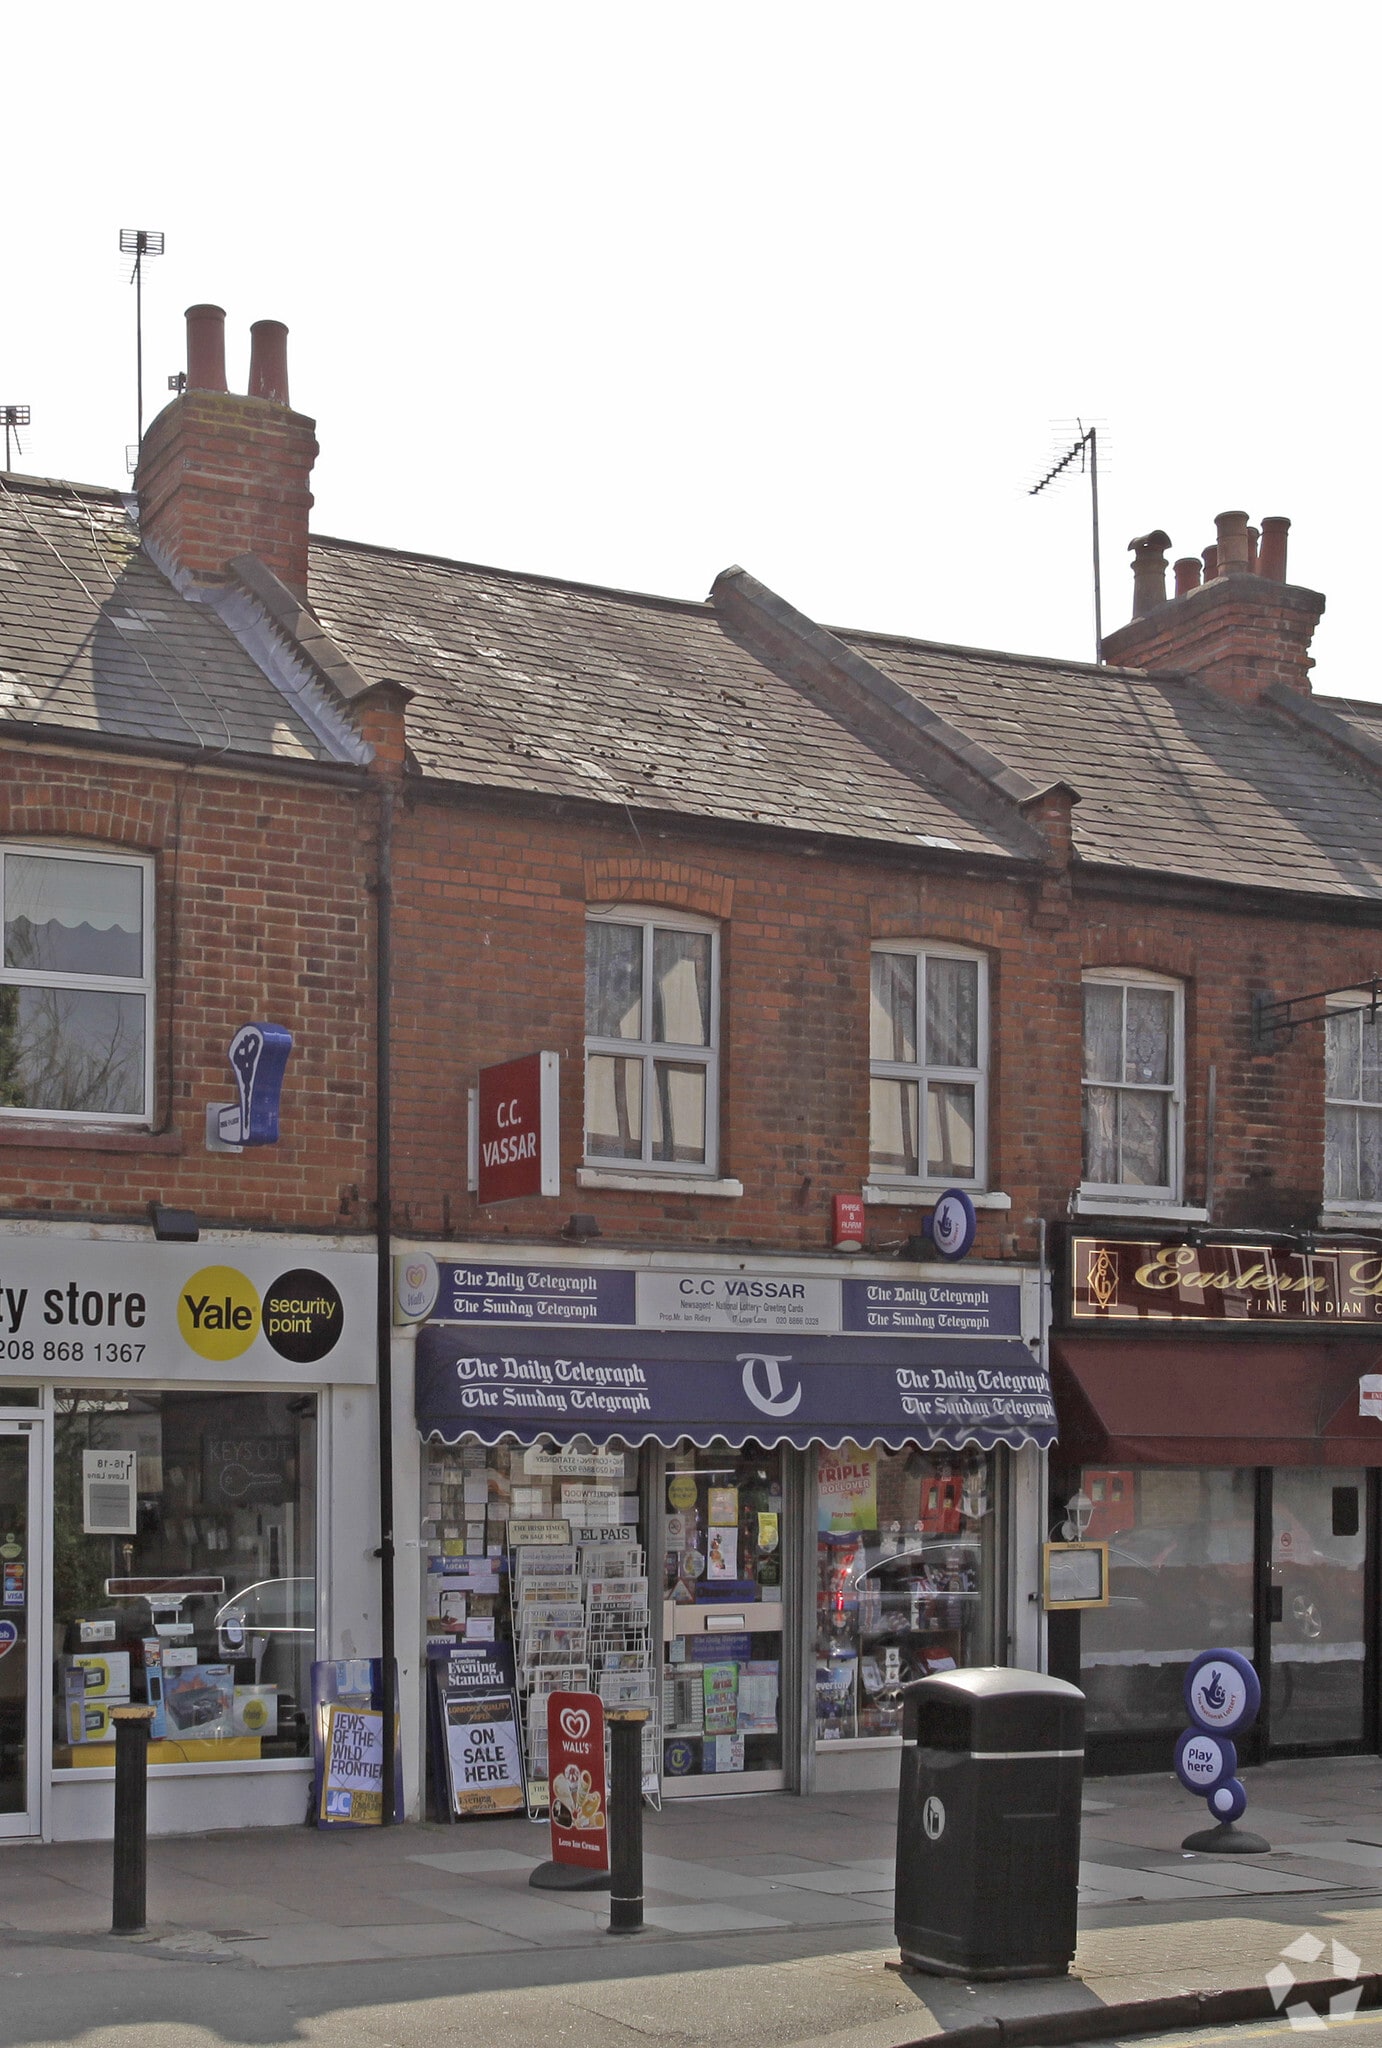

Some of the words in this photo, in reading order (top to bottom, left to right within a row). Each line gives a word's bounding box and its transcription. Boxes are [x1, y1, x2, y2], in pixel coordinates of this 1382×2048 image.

[497, 1099, 522, 1128] C.C.
[483, 1132, 536, 1168] VASSAR
[1135, 1248, 1330, 1293] Eastern
[453, 1269, 483, 1286] The
[486, 1271, 524, 1292] Daily
[527, 1272, 598, 1293] Telegraph
[679, 1278, 716, 1295] C.C
[725, 1281, 806, 1299] VASSAR
[44, 1282, 146, 1328] store
[867, 1286, 892, 1301] The
[894, 1286, 928, 1305] Daily
[930, 1287, 989, 1304] Telegraph
[184, 1294, 252, 1331] Yale
[269, 1298, 336, 1319] security
[453, 1298, 480, 1314] The
[483, 1300, 534, 1318] Sunday
[536, 1301, 598, 1318] Telegraph
[716, 1301, 739, 1310] National
[764, 1302, 786, 1314] Greeting
[788, 1304, 804, 1313] Cards
[1246, 1300, 1288, 1312] FINE
[1302, 1301, 1362, 1314] INDIAN
[269, 1316, 312, 1336] point
[694, 1314, 712, 1323] Ridley
[776, 1316, 787, 1324] 020
[867, 1312, 890, 1326] The
[892, 1312, 936, 1329] Sunday
[938, 1314, 990, 1330] Telegraph
[44, 1342, 84, 1362] 868
[94, 1343, 146, 1362] 1367
[456, 1358, 498, 1380] The
[500, 1357, 554, 1384] Daily
[554, 1360, 646, 1387] Telegraph
[896, 1368, 930, 1390] The
[932, 1370, 977, 1393] Daily
[977, 1370, 1049, 1392] Telegraph
[736, 1353, 802, 1416] T
[461, 1388, 499, 1408] The
[502, 1389, 568, 1412] Sunday
[570, 1390, 651, 1414] Telegraph
[902, 1396, 932, 1414] The
[935, 1396, 990, 1417] Sunday
[818, 1463, 870, 1483] TRIPLE
[822, 1480, 870, 1494] ROLLOVER
[580, 1530, 598, 1540] EL
[601, 1529, 630, 1540] PAIS
[448, 1660, 496, 1674] Evening
[448, 1672, 504, 1686] Standard
[1200, 1704, 1223, 1720] National
[1223, 1694, 1236, 1717] Lottery
[335, 1714, 364, 1730] JEWS
[334, 1729, 349, 1744] OF
[352, 1730, 374, 1748] THE
[470, 1728, 495, 1745] ON
[333, 1744, 362, 1761] WILD
[464, 1746, 505, 1764] SALE
[562, 1741, 589, 1754] WALL'S
[1189, 1748, 1212, 1760] Play
[465, 1764, 509, 1782] HERE
[1187, 1760, 1213, 1772] here
[327, 1791, 350, 1812] JC
[558, 1838, 571, 1848] Love
[582, 1842, 600, 1852] Cream
